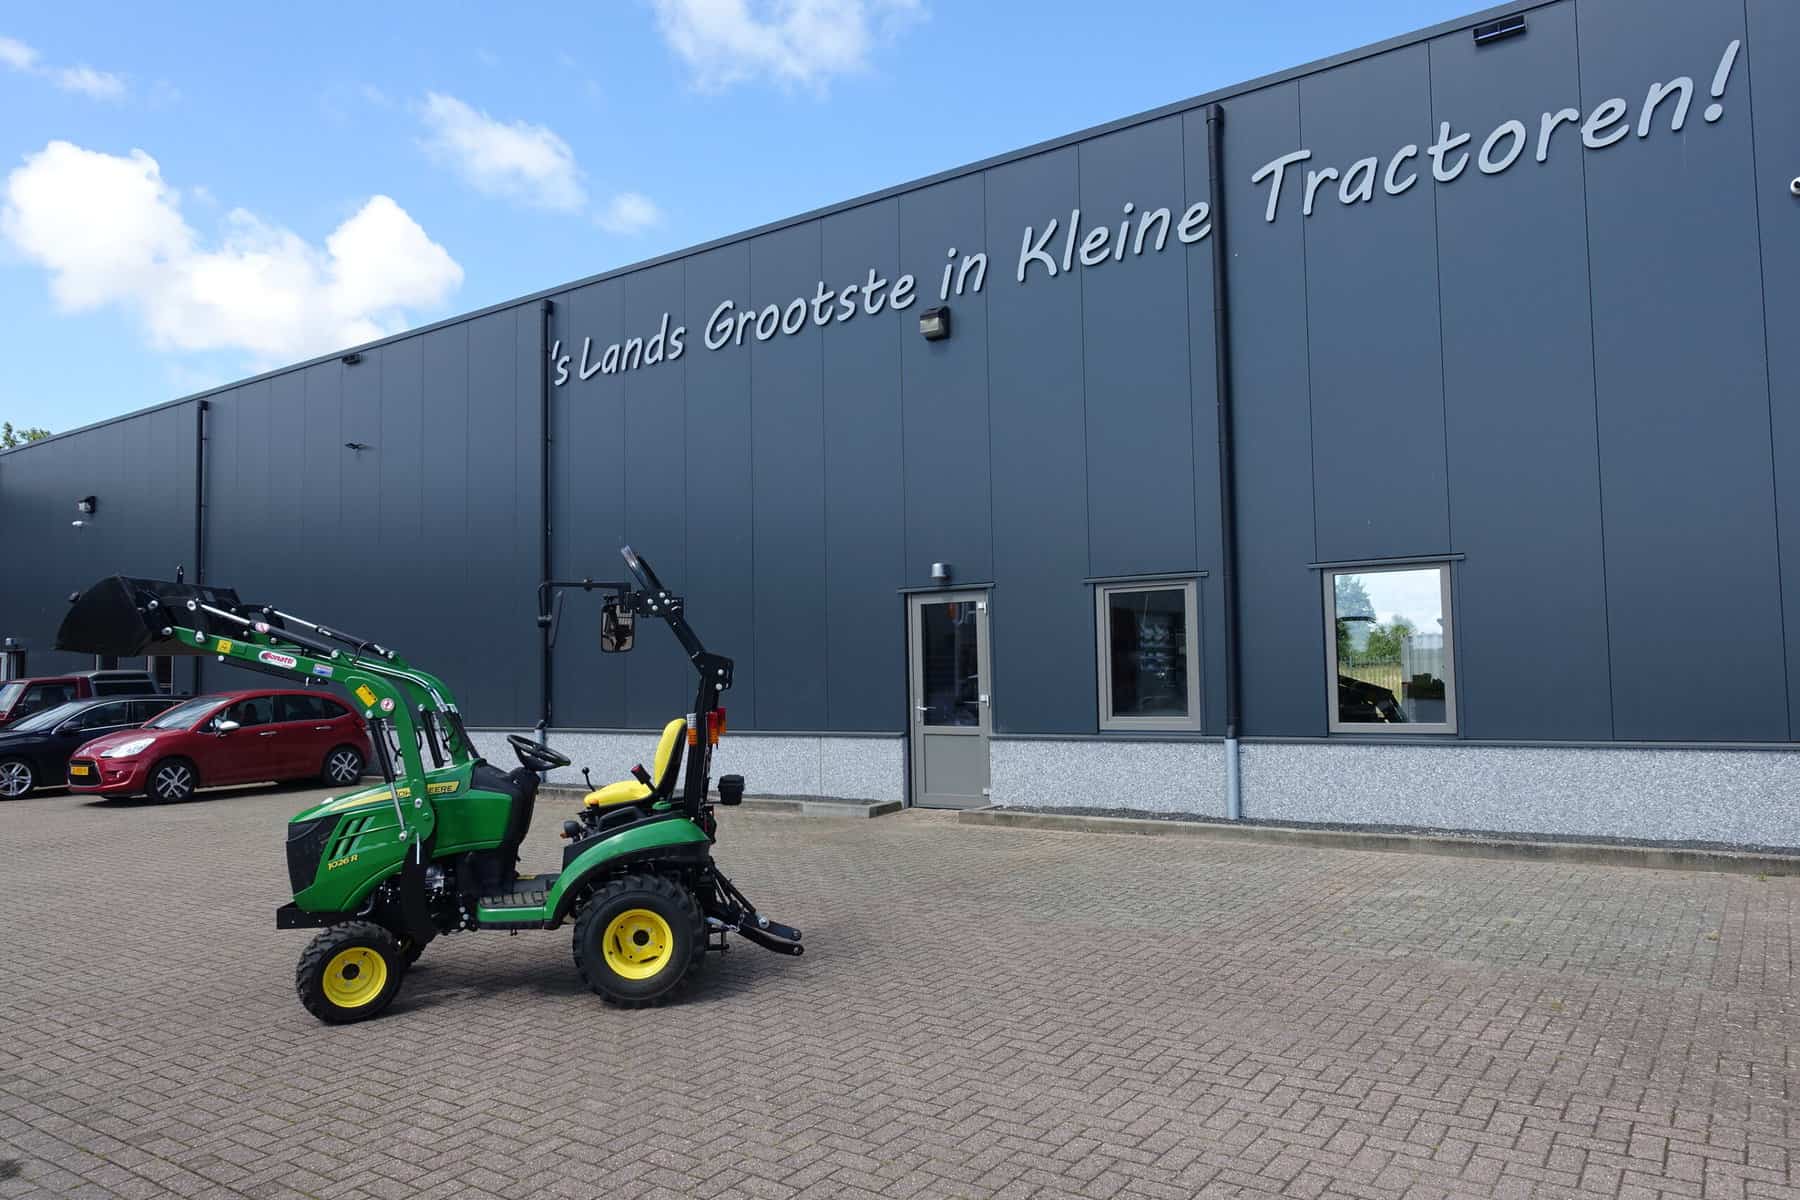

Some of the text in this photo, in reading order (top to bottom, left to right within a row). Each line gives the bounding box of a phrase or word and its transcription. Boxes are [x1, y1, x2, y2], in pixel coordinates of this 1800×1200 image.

[550, 39, 1741, 387] 's Lands Grootste in Kleine Tractoren!
